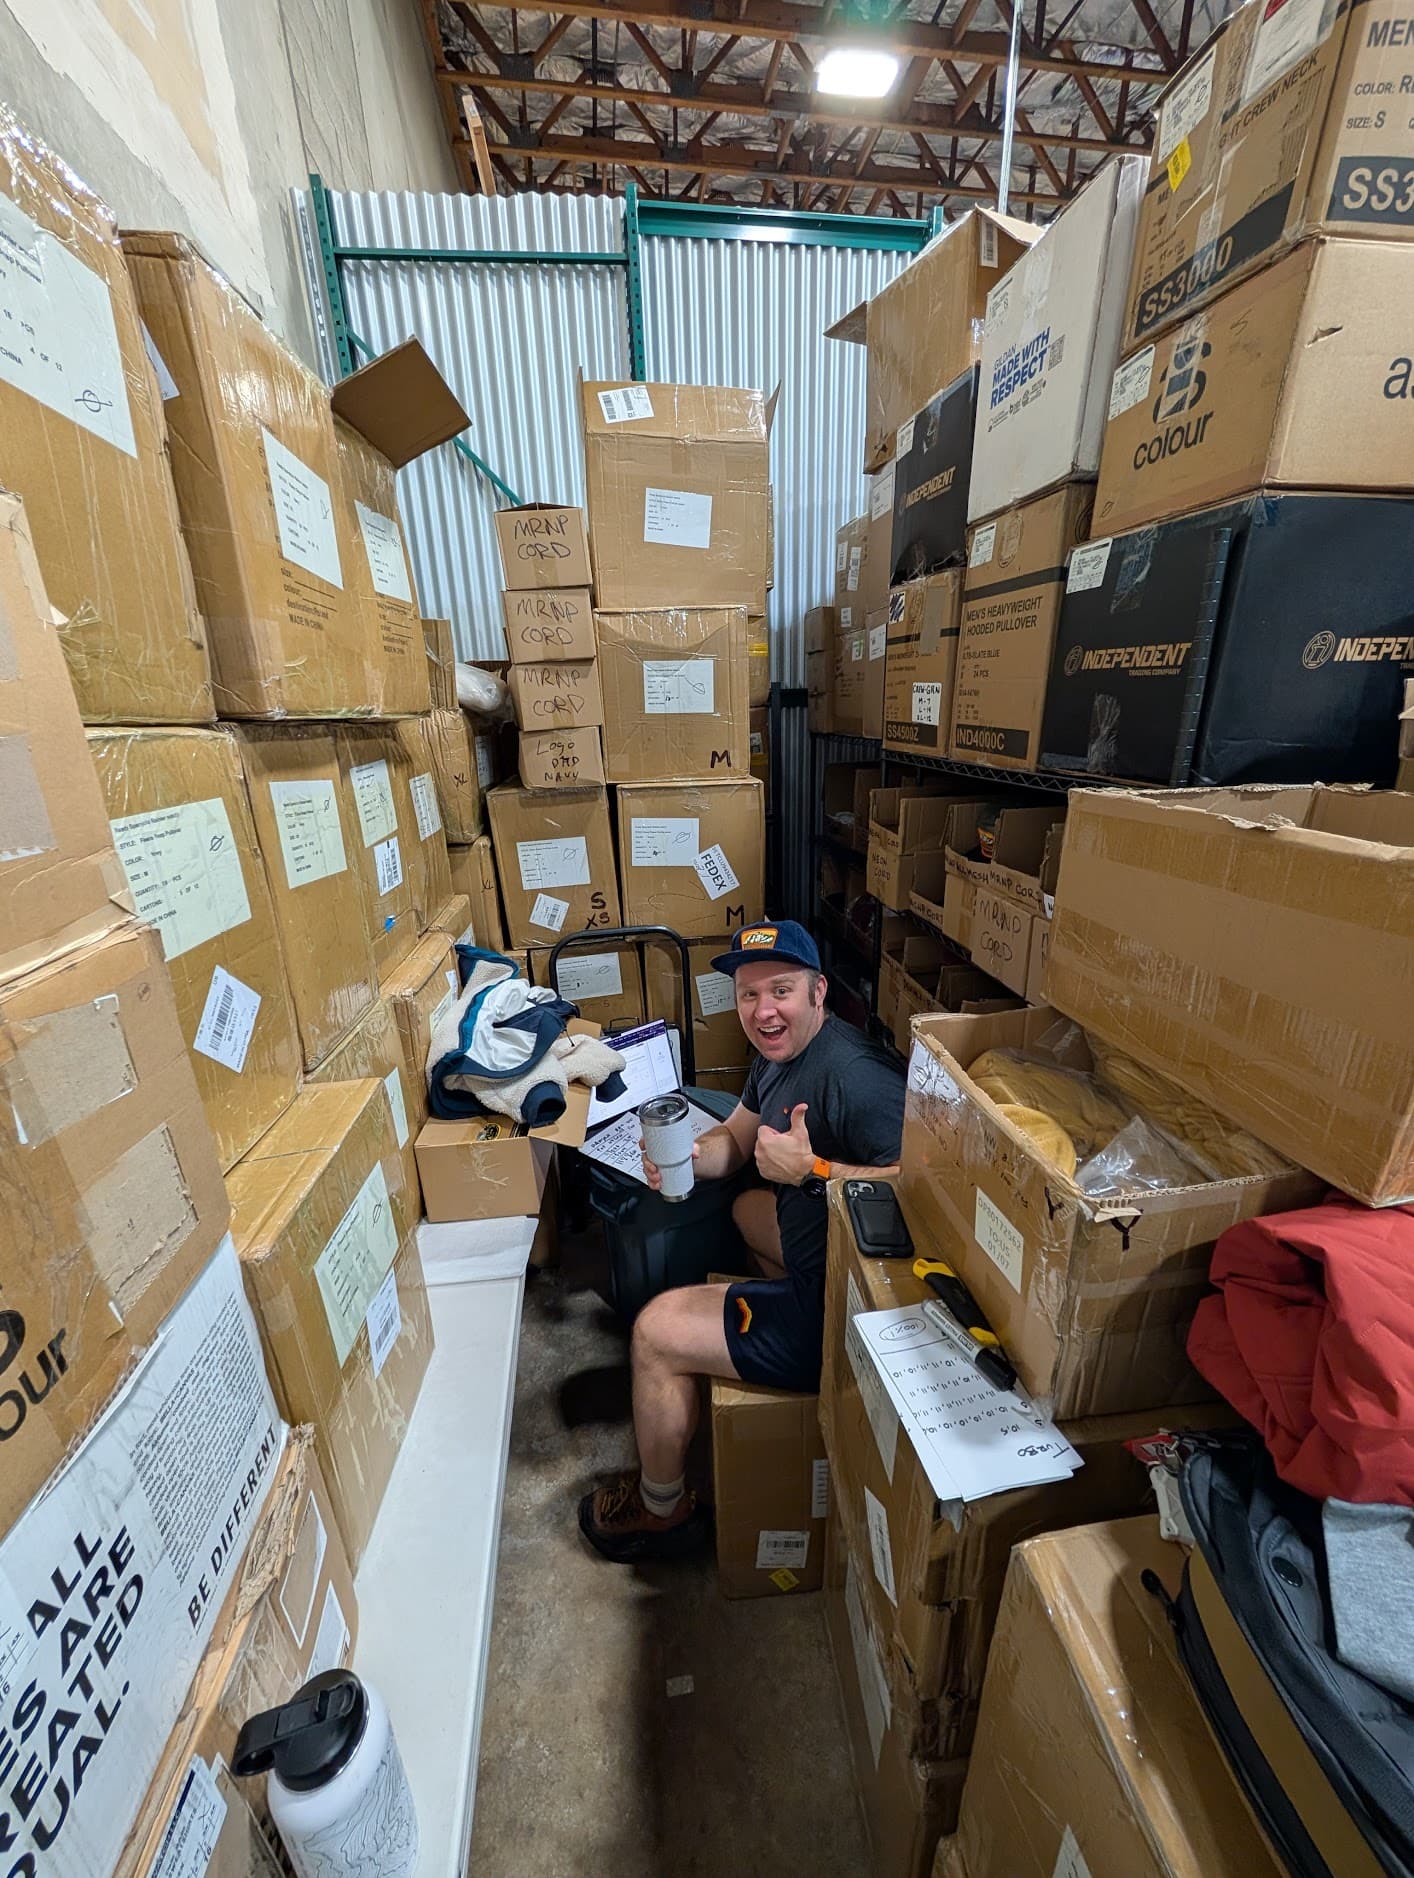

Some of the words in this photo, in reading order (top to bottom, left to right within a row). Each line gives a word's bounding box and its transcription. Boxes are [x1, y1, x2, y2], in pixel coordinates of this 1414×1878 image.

[1243, 86, 1281, 127] CREW
[1281, 48, 1320, 92] NECK
[1354, 82, 1394, 96] COLOR:
[1346, 116, 1373, 129] SIZE:
[1374, 110, 1386, 128] S
[1143, 236, 1234, 324] SS3000
[0, 345, 22, 367] CHINA
[993, 352, 1019, 387] MADE
[1022, 327, 1051, 362] WITH
[990, 348, 1048, 410] RESPECT
[1383, 357, 1414, 399] a
[1133, 410, 1214, 471] colour
[905, 466, 956, 508] INDEPENDENT
[514, 514, 568, 539] MRNP
[518, 542, 571, 560] CORD
[516, 599, 578, 623] MRNP
[967, 607, 986, 622] MEN'S
[987, 596, 1043, 618] HEAVYWEIGHT
[521, 627, 574, 645] CORD
[967, 621, 995, 636] HOODED
[996, 615, 1037, 632] PULLOVER
[1081, 643, 1192, 670] INDEPENDENT
[523, 668, 580, 688] MRNP
[1129, 669, 1151, 677] TRADING
[1152, 668, 1182, 676] COMPANY
[533, 694, 584, 716] CORD
[888, 725, 919, 741] SS4500Z
[956, 728, 1005, 750] IND4000C
[710, 750, 732, 768] M
[545, 772, 579, 782] NAVY
[872, 854, 887, 865] NEON
[701, 853, 727, 891] FEDEX
[874, 867, 891, 880] CORD
[590, 891, 607, 910] S
[162, 909, 176, 918] CHINA
[585, 912, 610, 930] XS
[726, 905, 745, 926] M
[980, 931, 1013, 961] CORD
[159, 1364, 194, 1425] BELLA+CANVAS
[188, 1573, 210, 1627] BE
[210, 1422, 279, 1576] DIFFERENT
[26, 1531, 103, 1640] ALL
[60, 1525, 136, 1680] ARE
